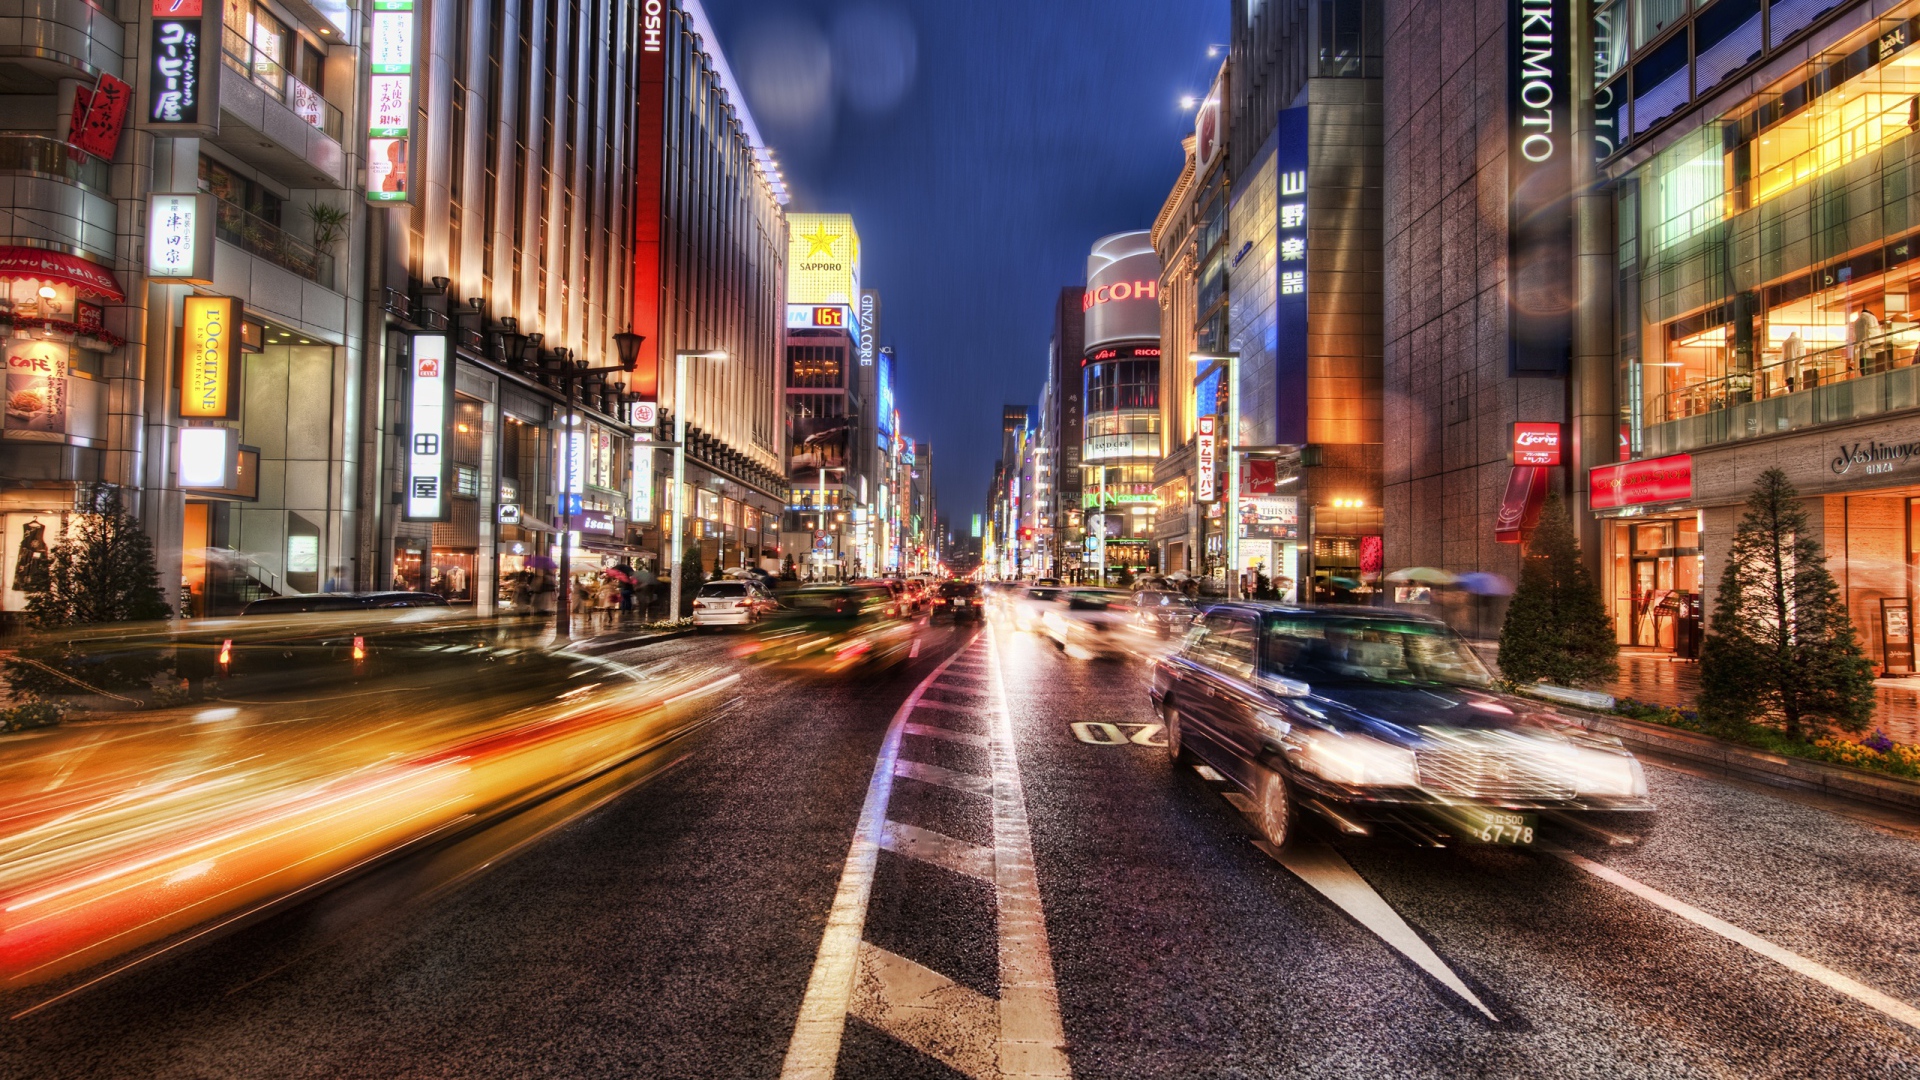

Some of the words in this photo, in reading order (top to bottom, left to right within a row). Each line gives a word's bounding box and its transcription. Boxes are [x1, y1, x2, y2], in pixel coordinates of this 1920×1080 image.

[645, 0, 661, 51] OSHI
[154, 23, 185, 121] コーヒー屋
[380, 82, 391, 113] すみか
[380, 192, 397, 200] 3F
[1282, 171, 1305, 294] 山野楽器
[800, 263, 842, 271] SAPPORO
[1082, 280, 1156, 312] RICOH
[861, 294, 873, 333] GINZA
[197, 327, 203, 339] EN
[202, 310, 222, 410] L'OCCITANE
[860, 334, 873, 367] CORE
[195, 343, 203, 392] PROVENCE
[413, 433, 438, 498] 田屋
[1201, 440, 1213, 497] キムラヤのパン
[1832, 441, 1920, 475] Yoshinoya
[1866, 463, 1893, 475] GINZA
[1597, 474, 1652, 489] Chocolate
[1652, 468, 1688, 483] Shop
[1482, 825, 1534, 844] 67-78
